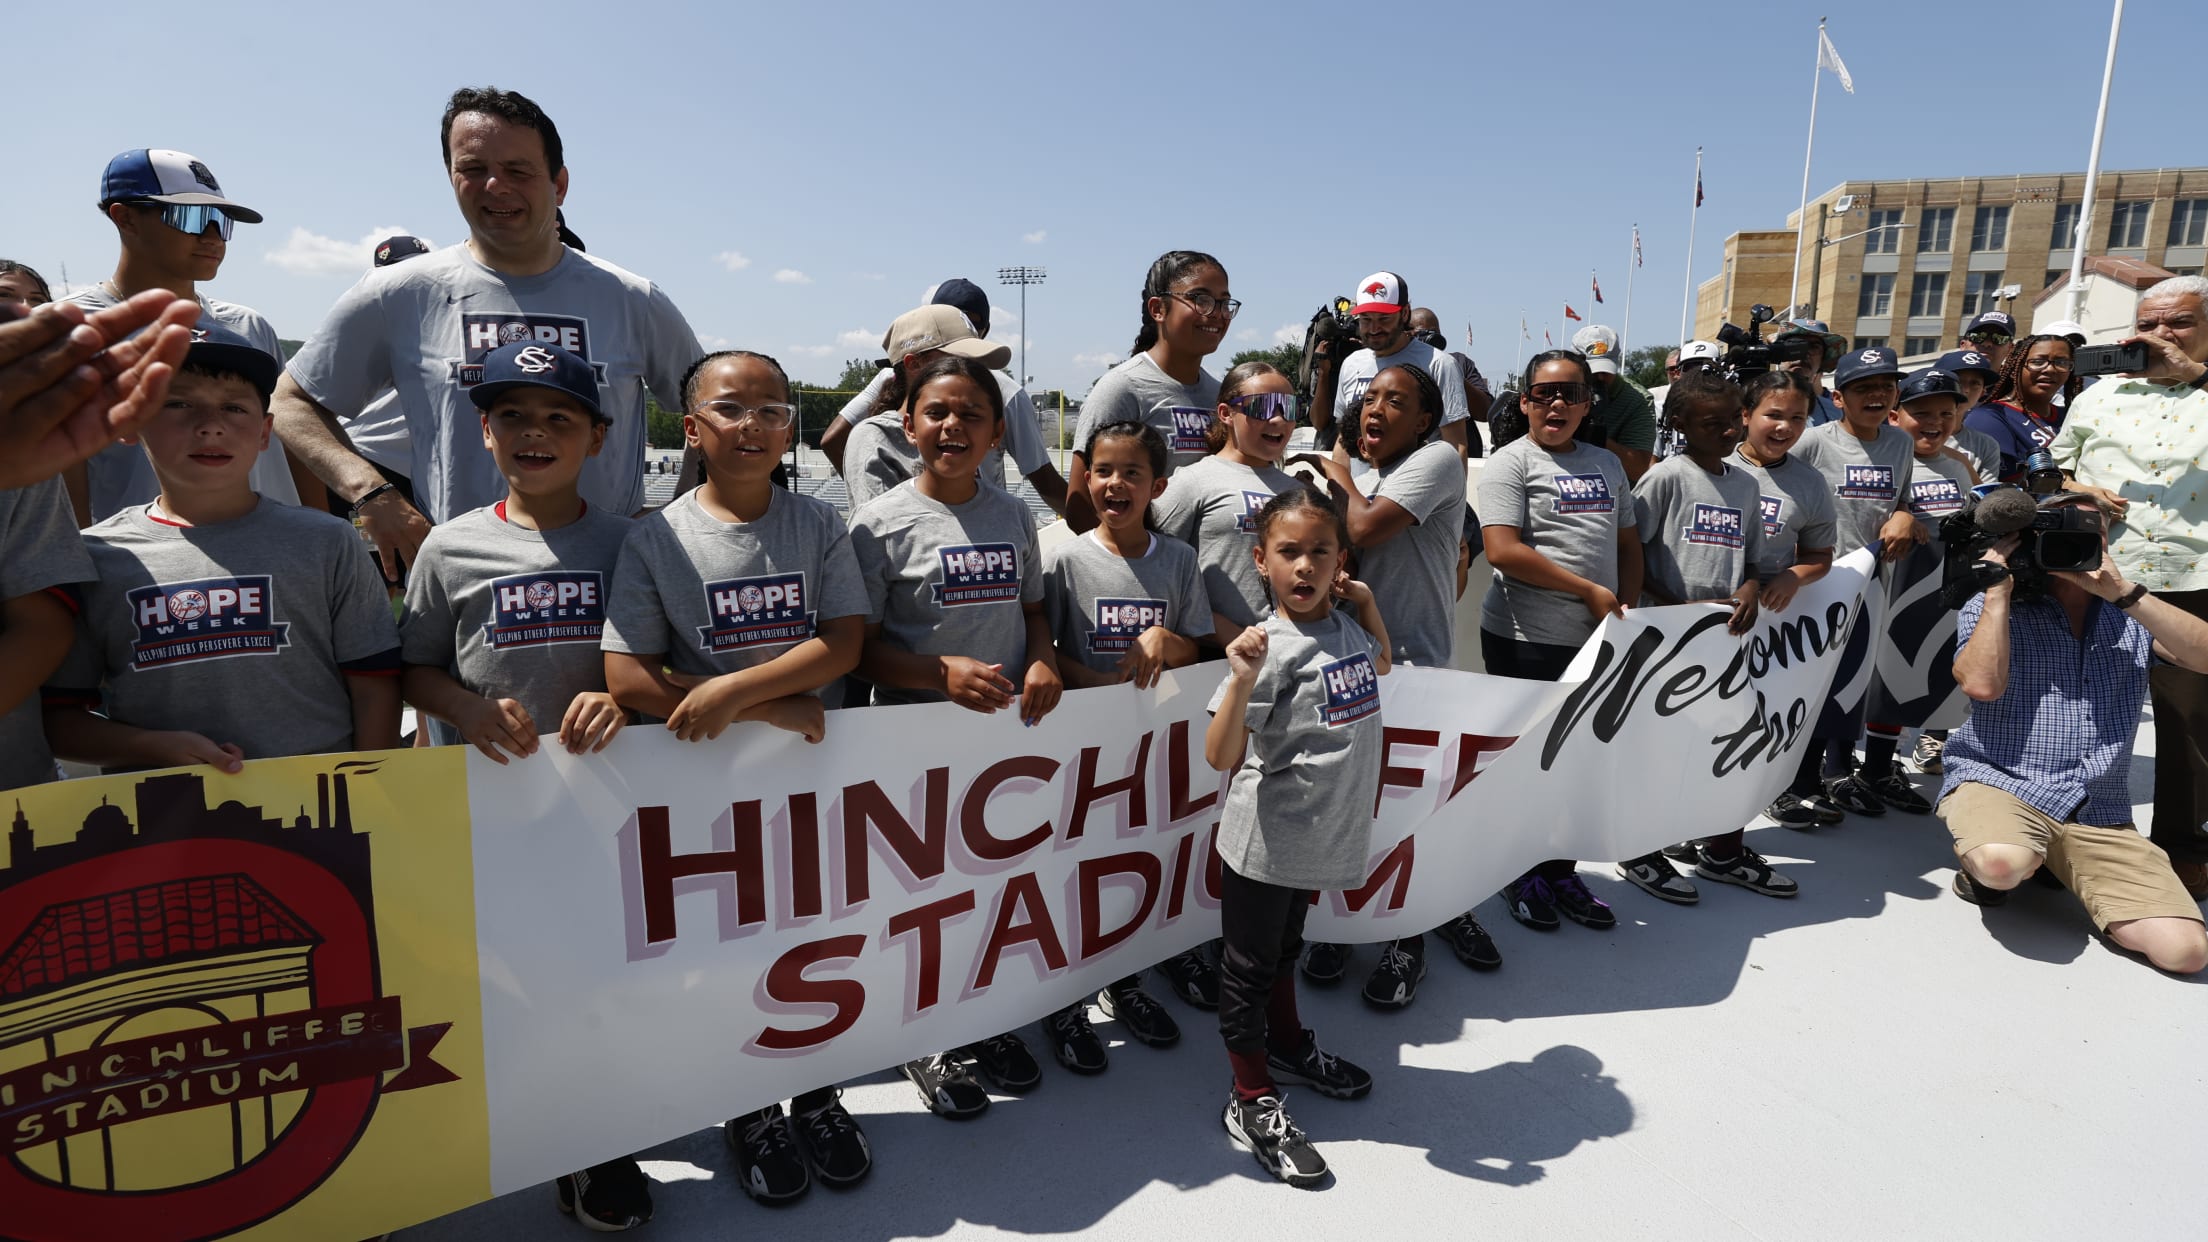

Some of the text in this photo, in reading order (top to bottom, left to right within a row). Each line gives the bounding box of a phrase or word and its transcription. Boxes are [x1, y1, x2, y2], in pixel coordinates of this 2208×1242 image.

[469, 322, 580, 352] HOPE
[464, 370, 485, 382] HELP
[1176, 412, 1211, 429] HOP
[1559, 478, 1606, 493] HOPE
[1849, 469, 1891, 483] HOPE
[1914, 483, 1958, 497] HOPE
[1697, 509, 1739, 529] HOPE
[944, 550, 1014, 575] HOPE
[958, 572, 1008, 582] WEEK
[499, 580, 597, 612] HOPE
[714, 582, 801, 616] HOPE
[139, 586, 262, 627] HOPE
[515, 608, 587, 620] WEEK
[1101, 604, 1163, 626] HOPE
[156, 616, 247, 635] WEEK
[730, 610, 793, 623] WEEK
[200, 637, 242, 652] PERSEVERE
[1327, 660, 1375, 694] HOPE
[1341, 684, 1373, 700] WEEK
[1712, 690, 1808, 778] the
[0, 1011, 366, 1107] INCHLIFFE
[13, 1061, 299, 1144] STADIUM
